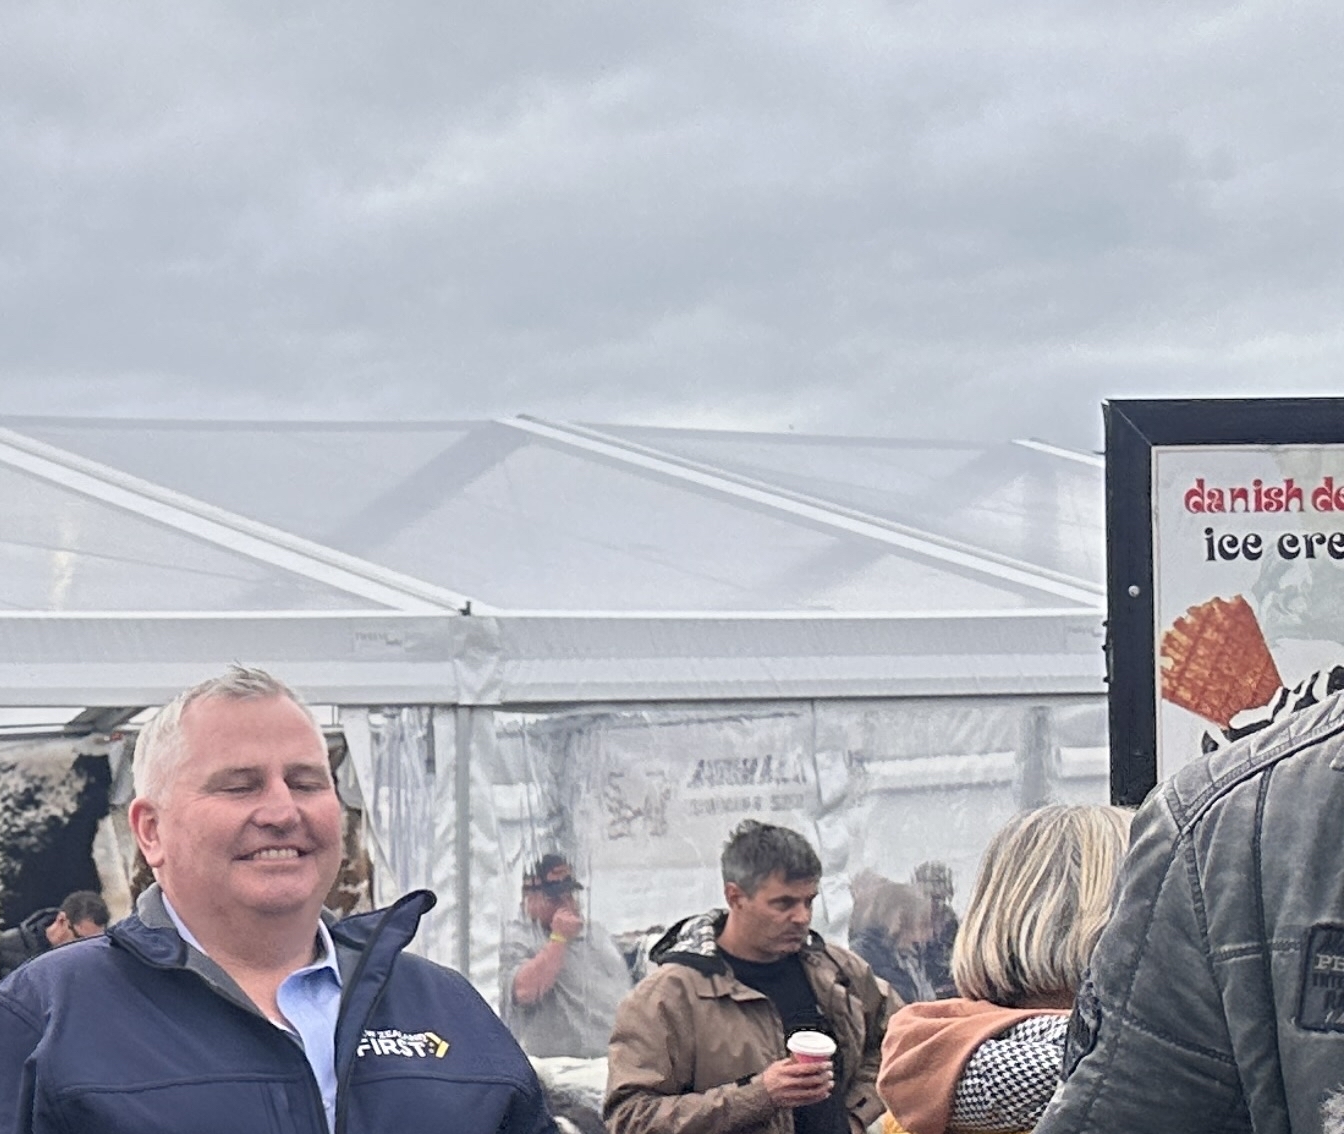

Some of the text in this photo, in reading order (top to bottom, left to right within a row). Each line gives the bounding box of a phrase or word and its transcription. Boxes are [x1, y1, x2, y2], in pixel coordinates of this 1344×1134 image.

[1184, 477, 1306, 514] danish
[1204, 526, 1344, 562] ice cre
[356, 1037, 427, 1058] FIRST
